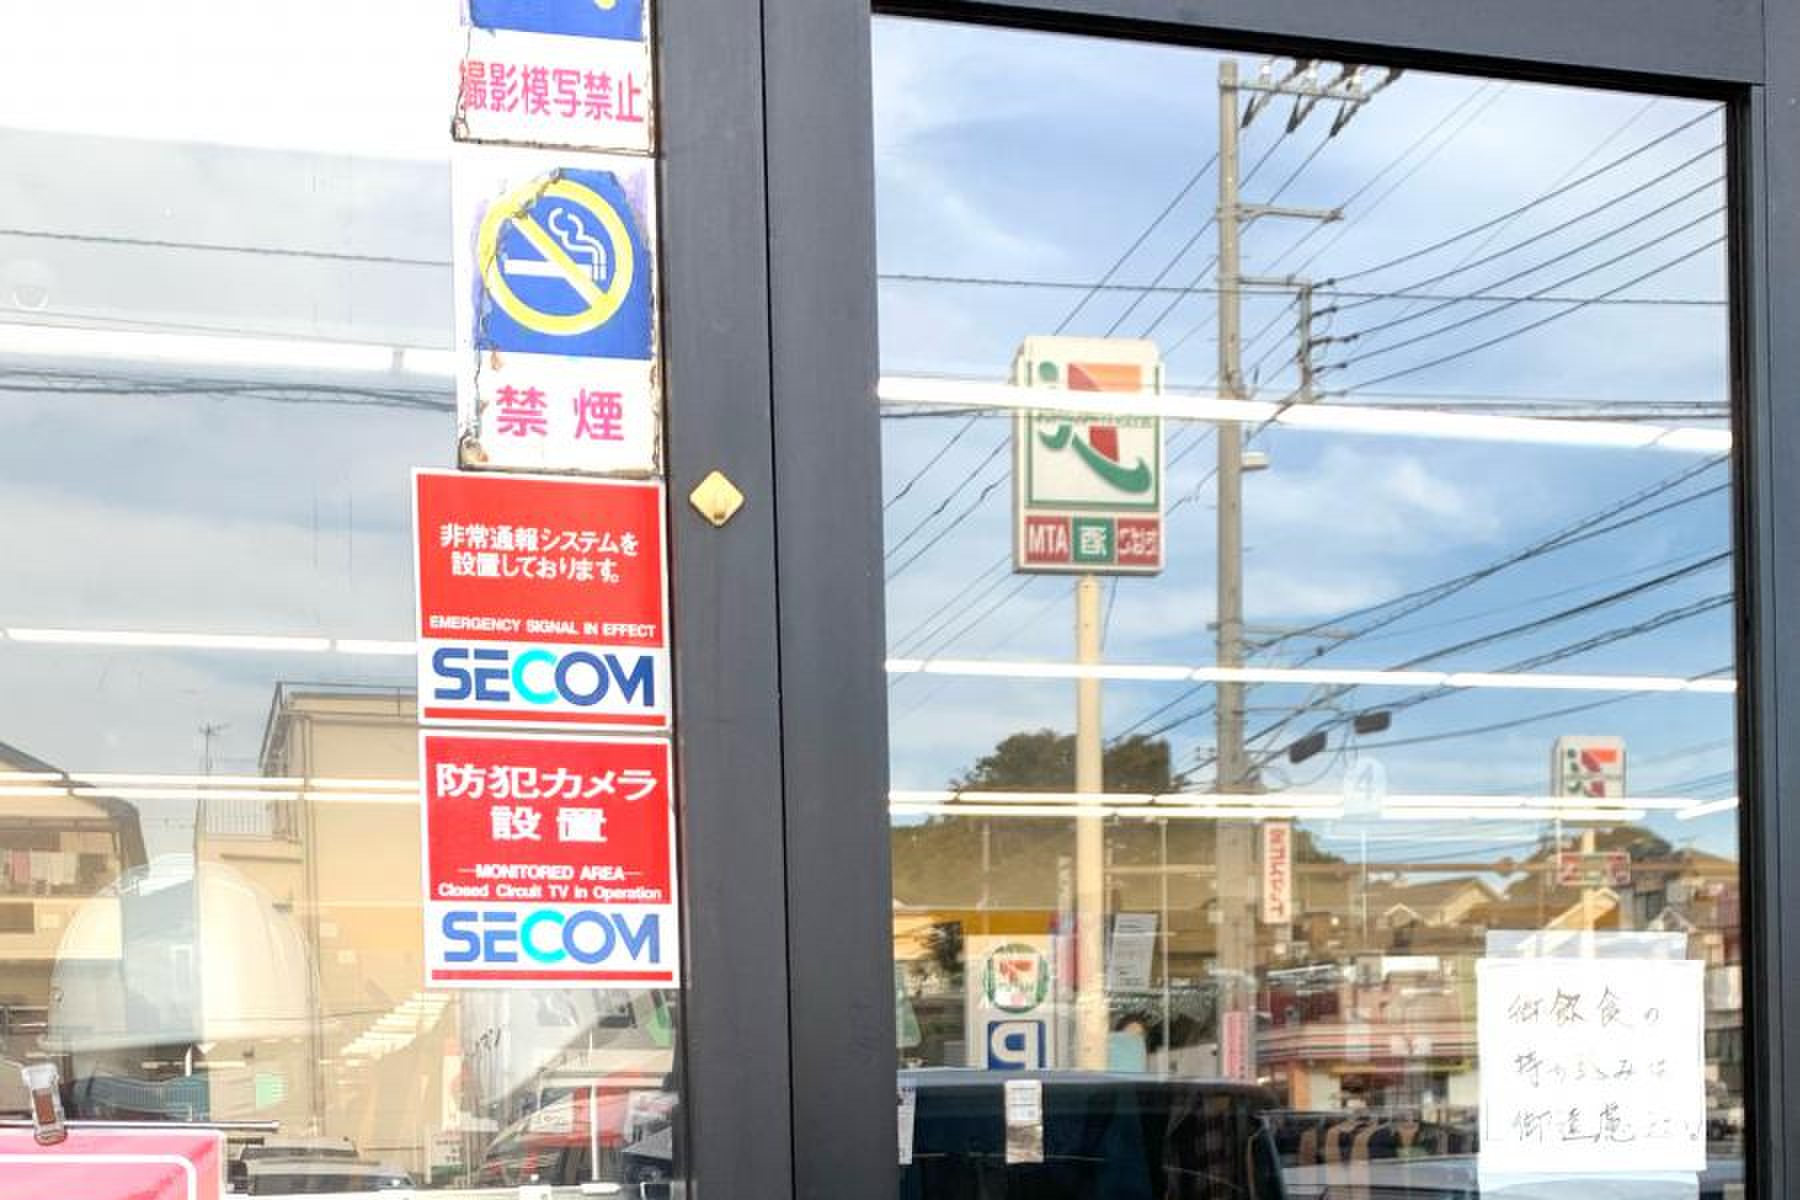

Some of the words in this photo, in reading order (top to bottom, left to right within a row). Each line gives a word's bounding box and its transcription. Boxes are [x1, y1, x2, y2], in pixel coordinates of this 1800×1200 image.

[459, 60, 644, 122] 撮影模写禁止
[496, 386, 625, 441] 禁煙
[440, 523, 639, 556] 非常通報システムを
[452, 552, 620, 583] 設置しております。
[430, 616, 522, 632] EMERGENCY
[526, 618, 578, 634] SIGNAL
[584, 622, 598, 635] IN
[603, 622, 656, 637] EFFECT
[432, 647, 655, 707] SECOM
[436, 763, 657, 801] 防犯カメラ
[490, 806, 608, 843] 設置
[475, 864, 574, 880] MONITORED
[580, 866, 625, 881] AREA
[438, 883, 489, 897] Closed
[496, 883, 542, 898] Circuit
[548, 885, 569, 898] TV
[593, 886, 662, 902] Operation
[442, 908, 660, 965] SECOM
